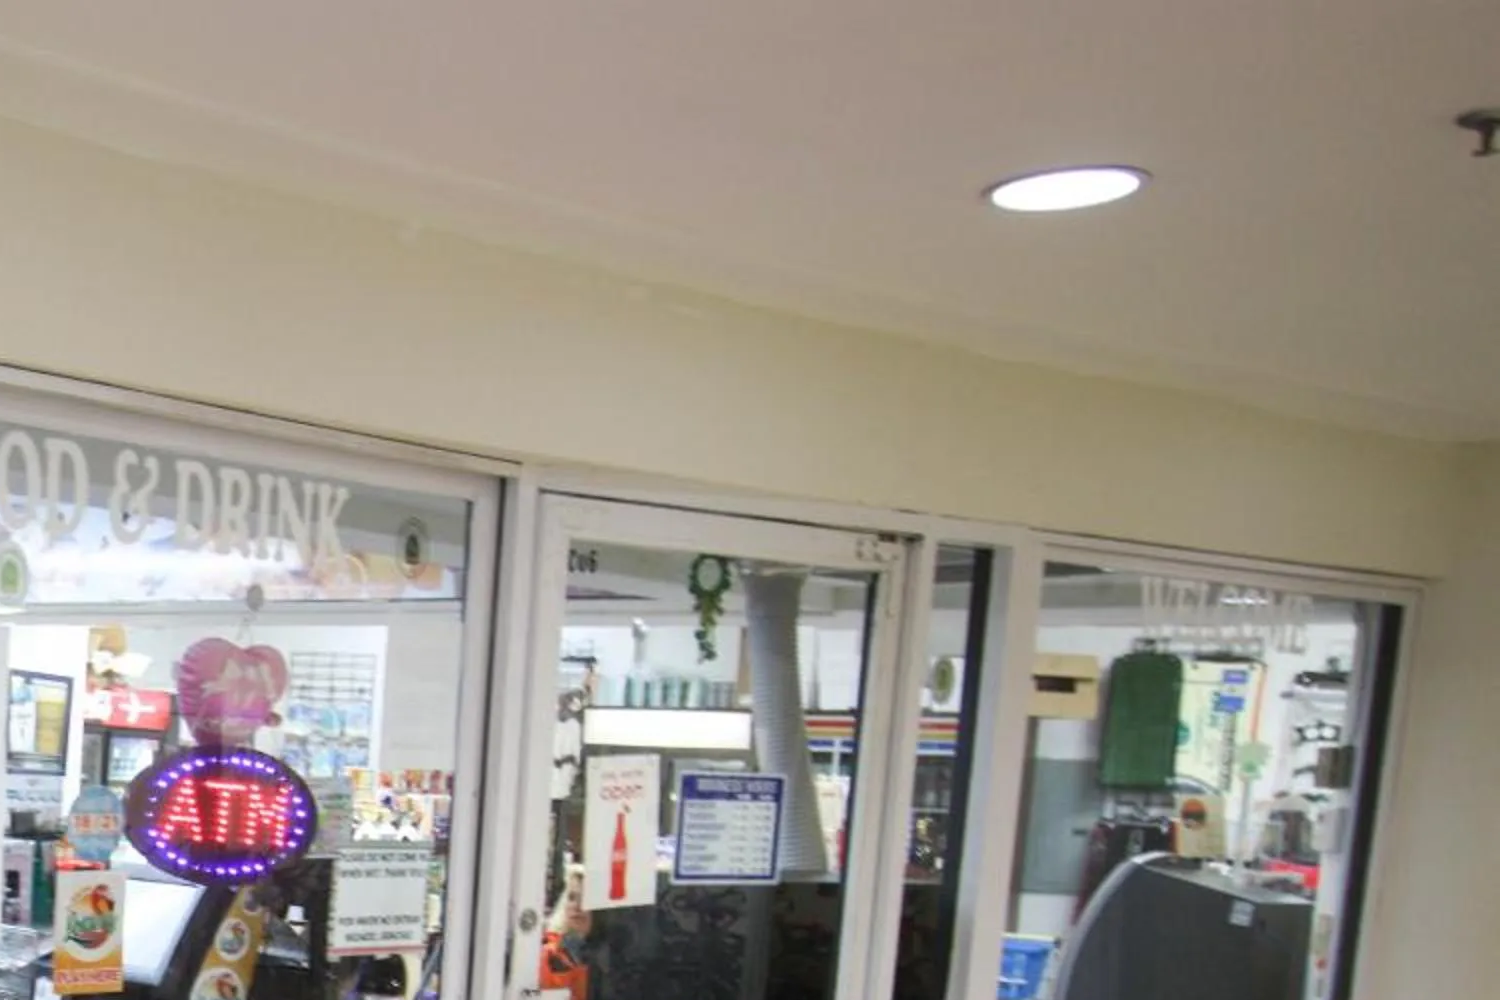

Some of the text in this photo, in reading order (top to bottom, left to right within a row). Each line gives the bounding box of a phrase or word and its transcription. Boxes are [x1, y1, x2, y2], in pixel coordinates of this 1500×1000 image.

[108, 448, 160, 545] &
[175, 460, 350, 566] DRINK
[158, 777, 294, 849] ATM
